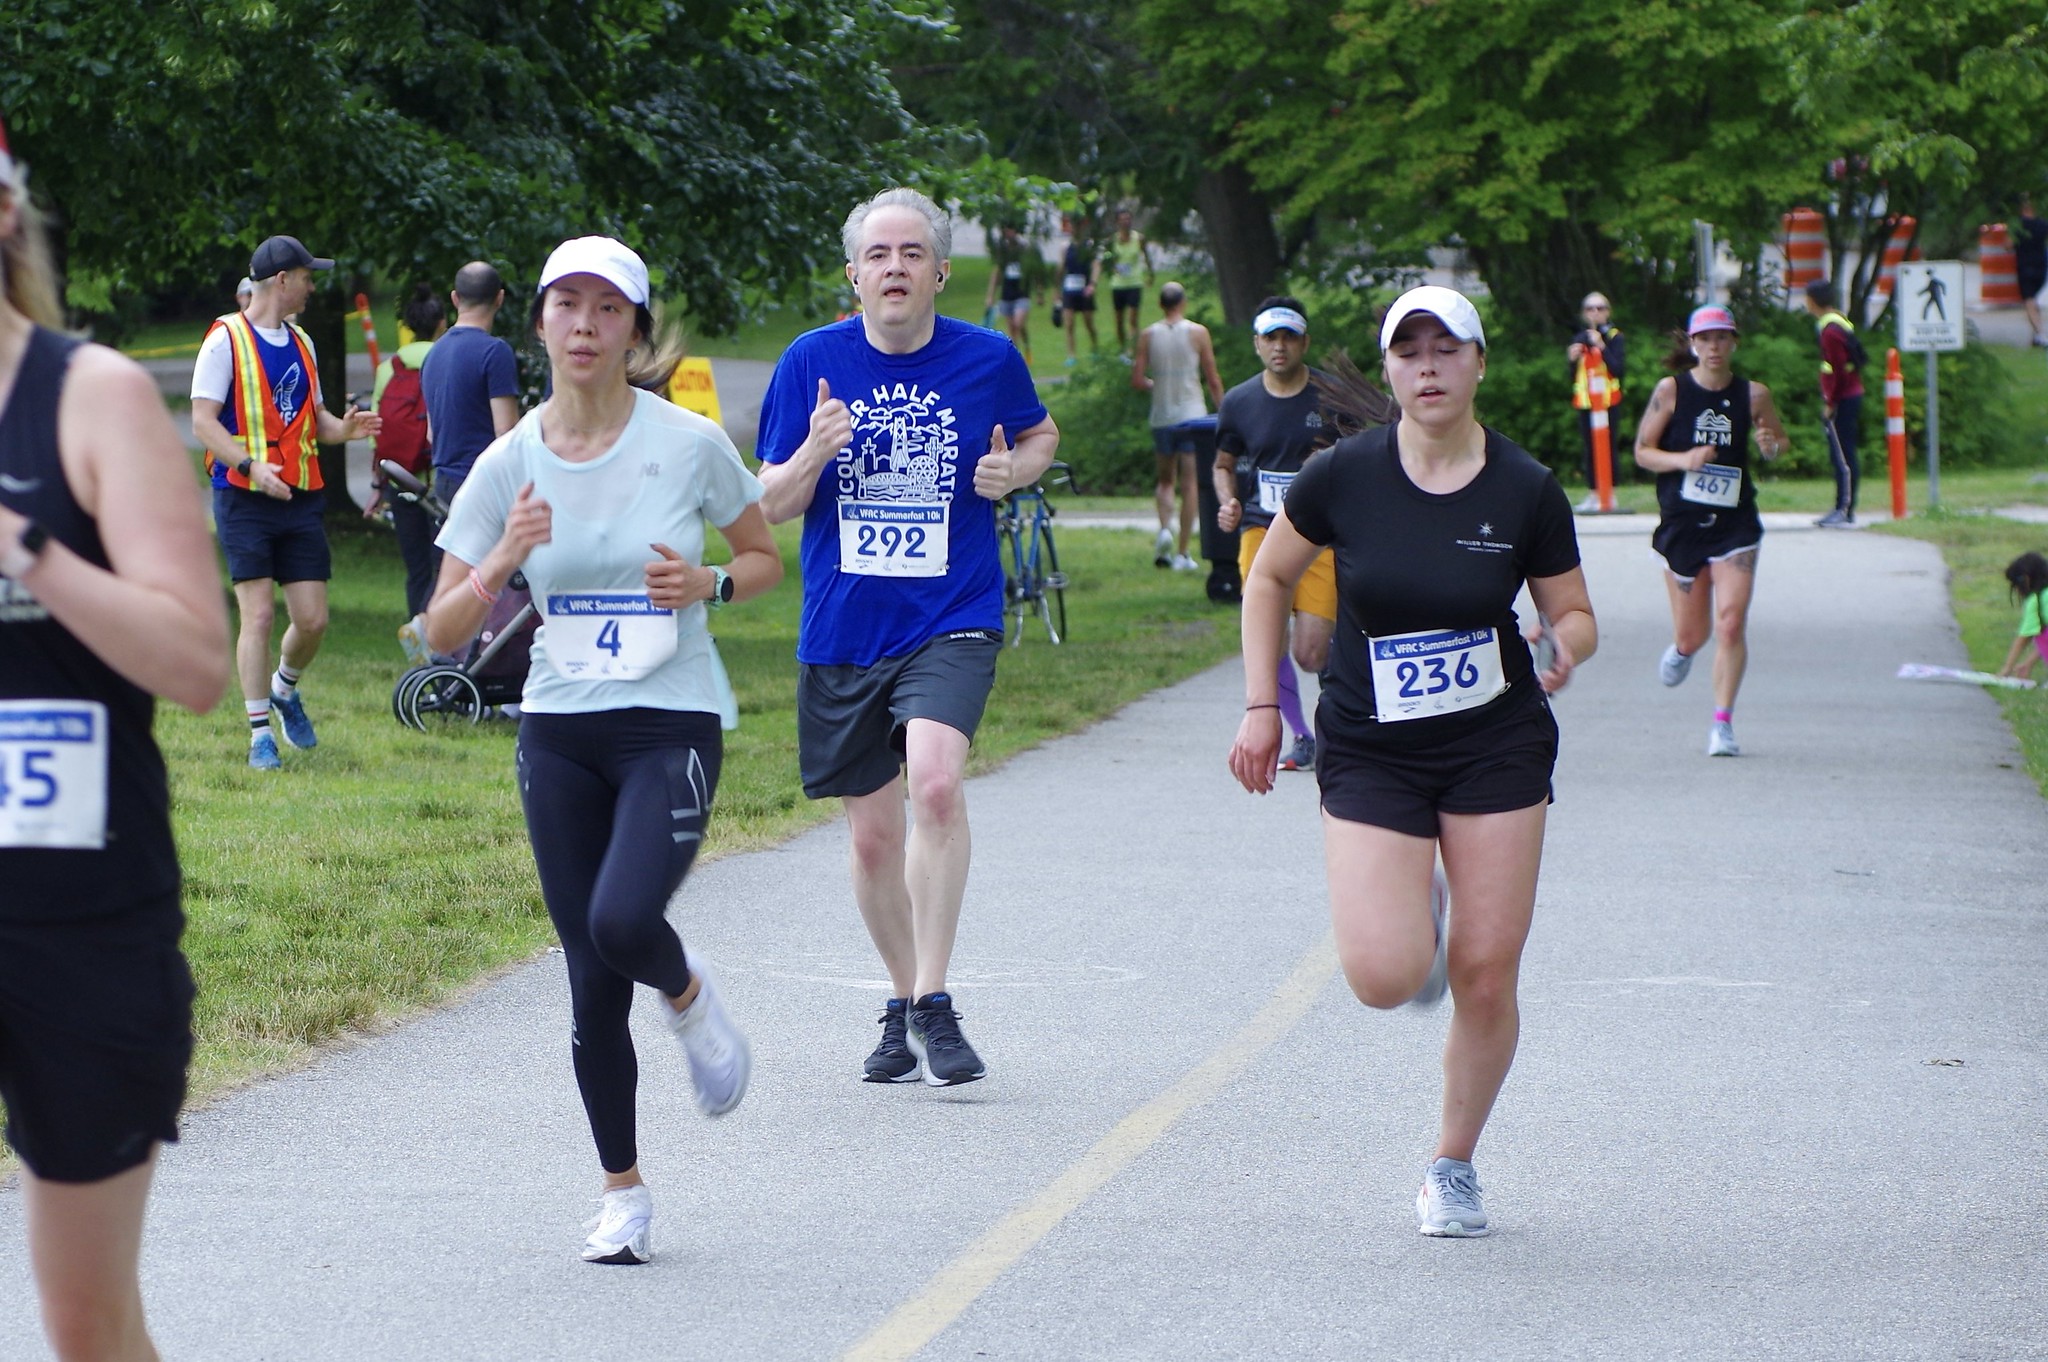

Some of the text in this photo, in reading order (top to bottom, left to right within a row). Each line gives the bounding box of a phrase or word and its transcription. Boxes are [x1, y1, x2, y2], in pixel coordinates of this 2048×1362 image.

[872, 383, 940, 407] HALF
[1695, 431, 1731, 445] M2M
[1694, 475, 1731, 496] 467
[857, 524, 926, 558] 292
[596, 618, 622, 658] 4
[1396, 652, 1479, 698] 236
